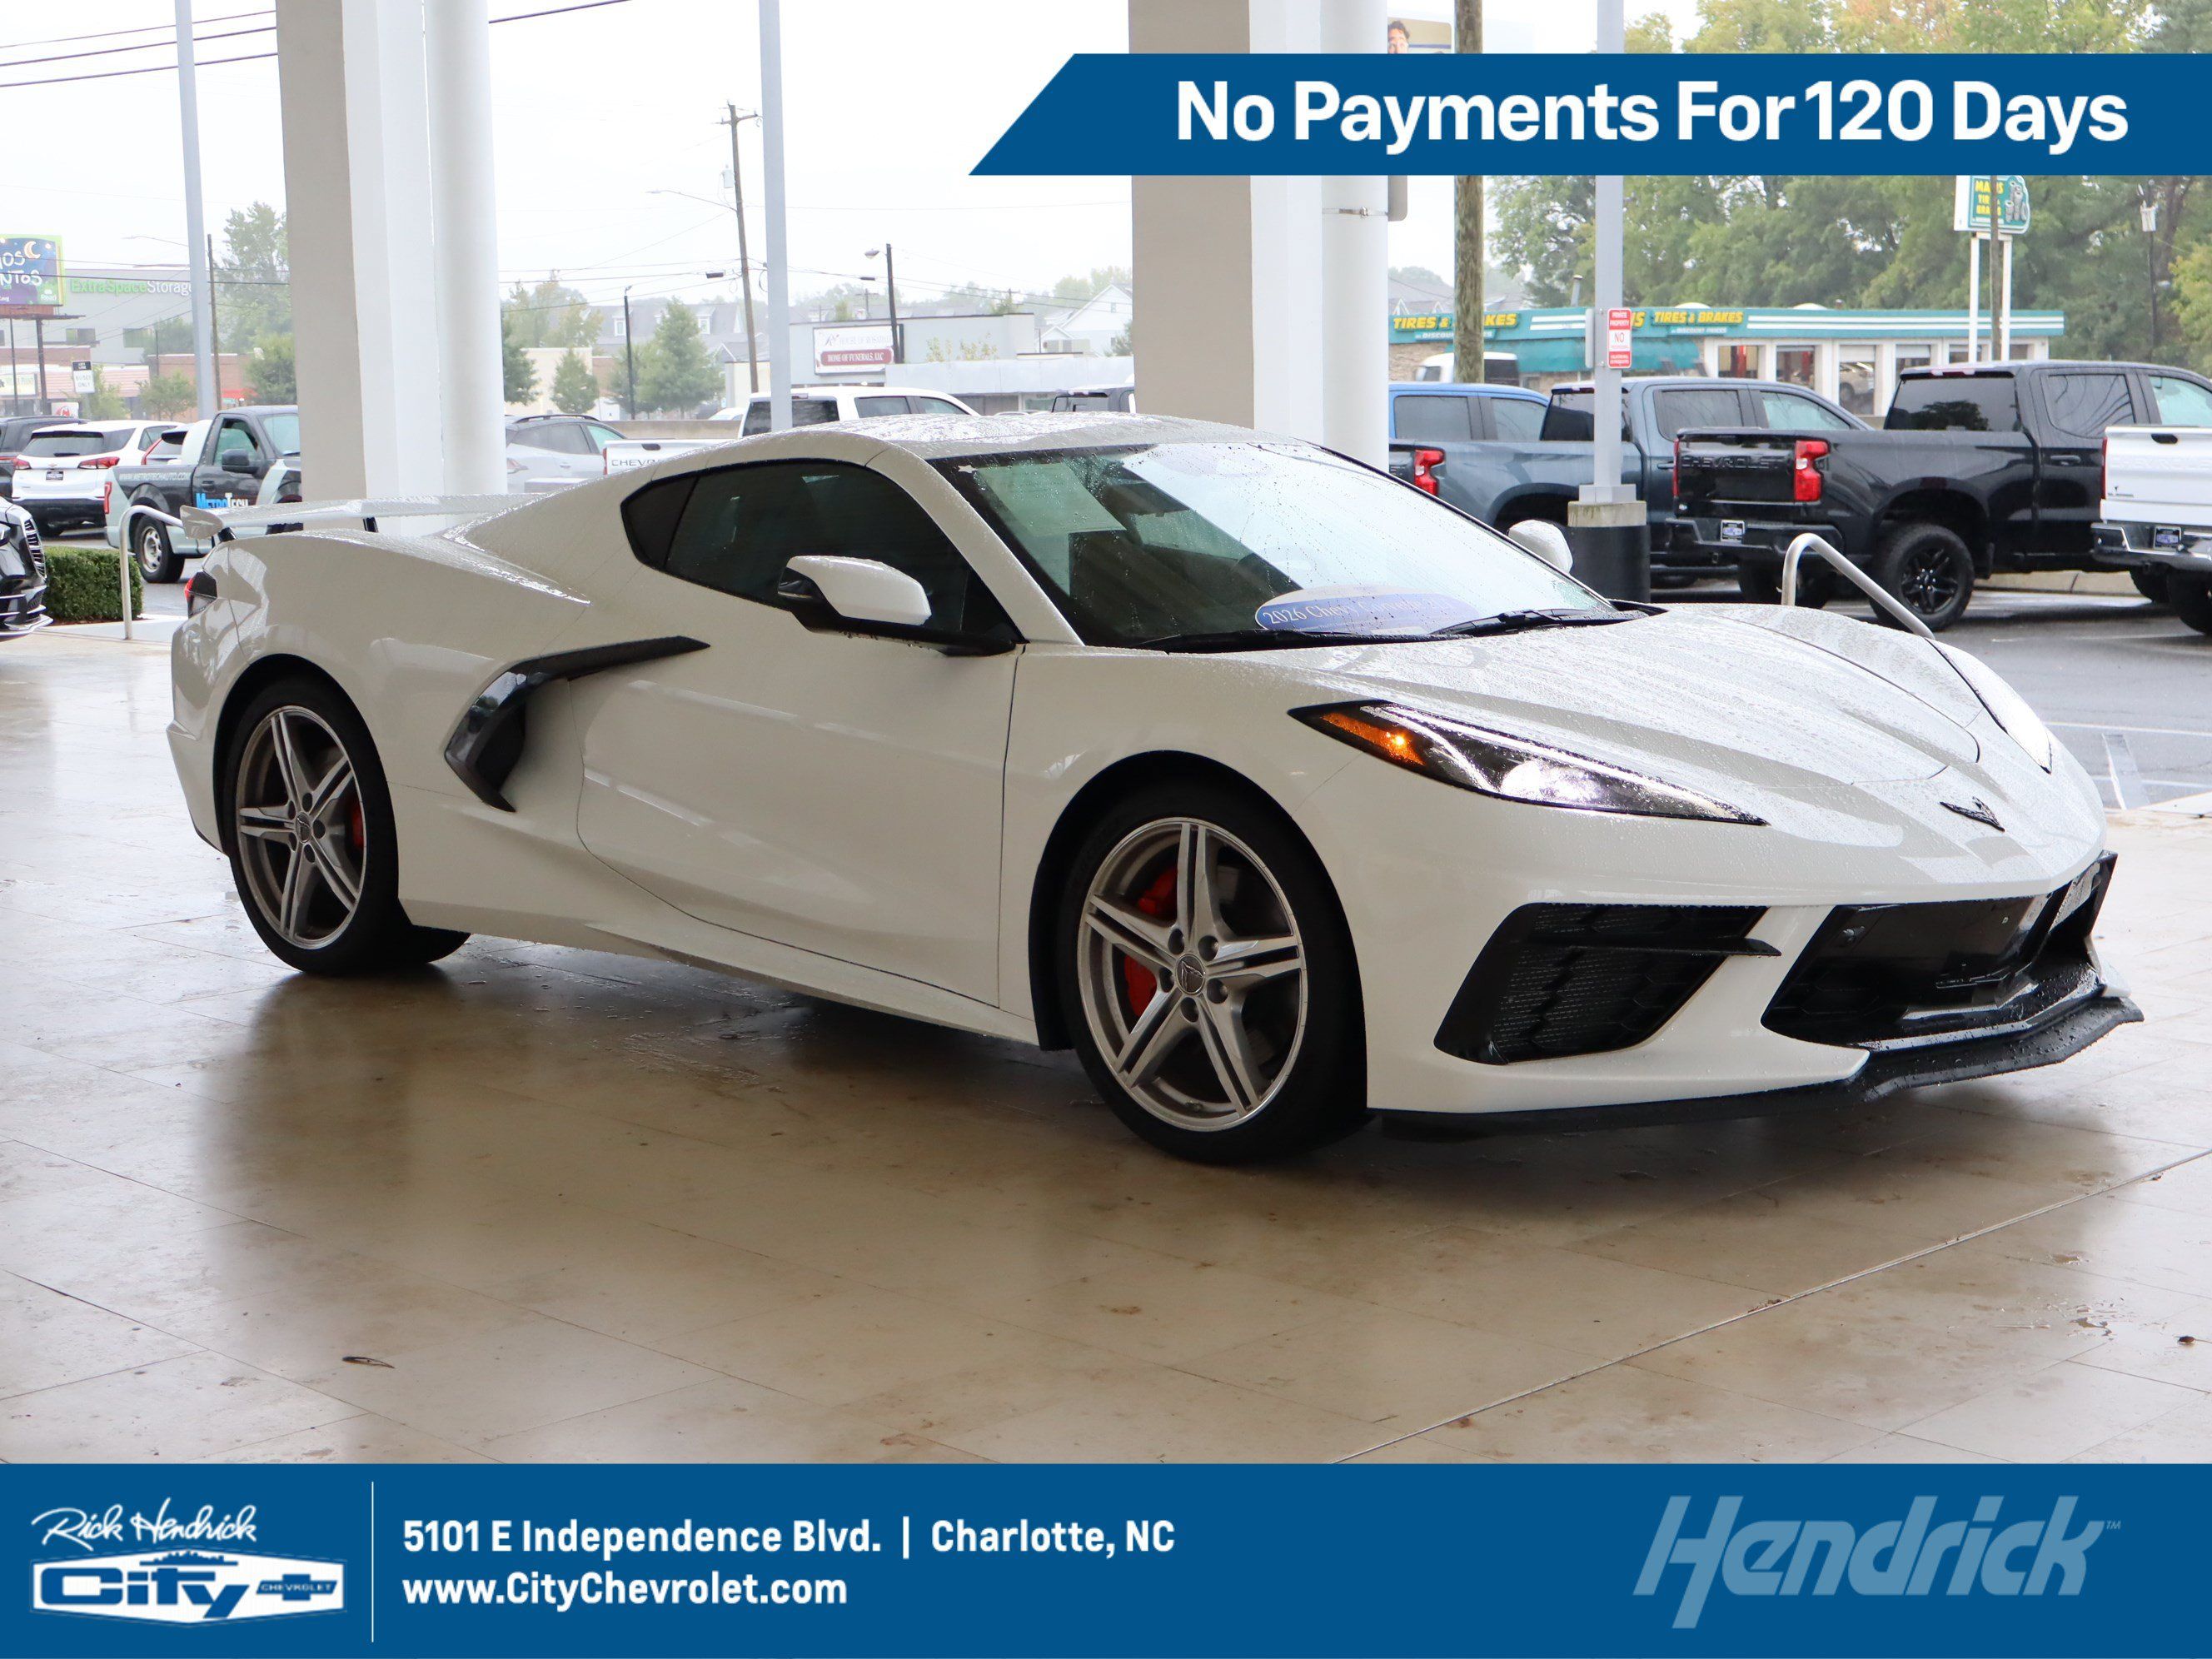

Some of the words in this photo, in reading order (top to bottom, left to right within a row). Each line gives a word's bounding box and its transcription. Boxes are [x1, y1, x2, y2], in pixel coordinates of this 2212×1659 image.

[0, 251, 26, 270] OS
[1392, 316, 1437, 330] TIRES
[1654, 311, 1687, 324] TIRES
[1697, 311, 1744, 324] BRAKES
[1614, 331, 1625, 343] NO
[1263, 608, 1308, 625] 2026
[1308, 605, 1359, 618] Chevy
